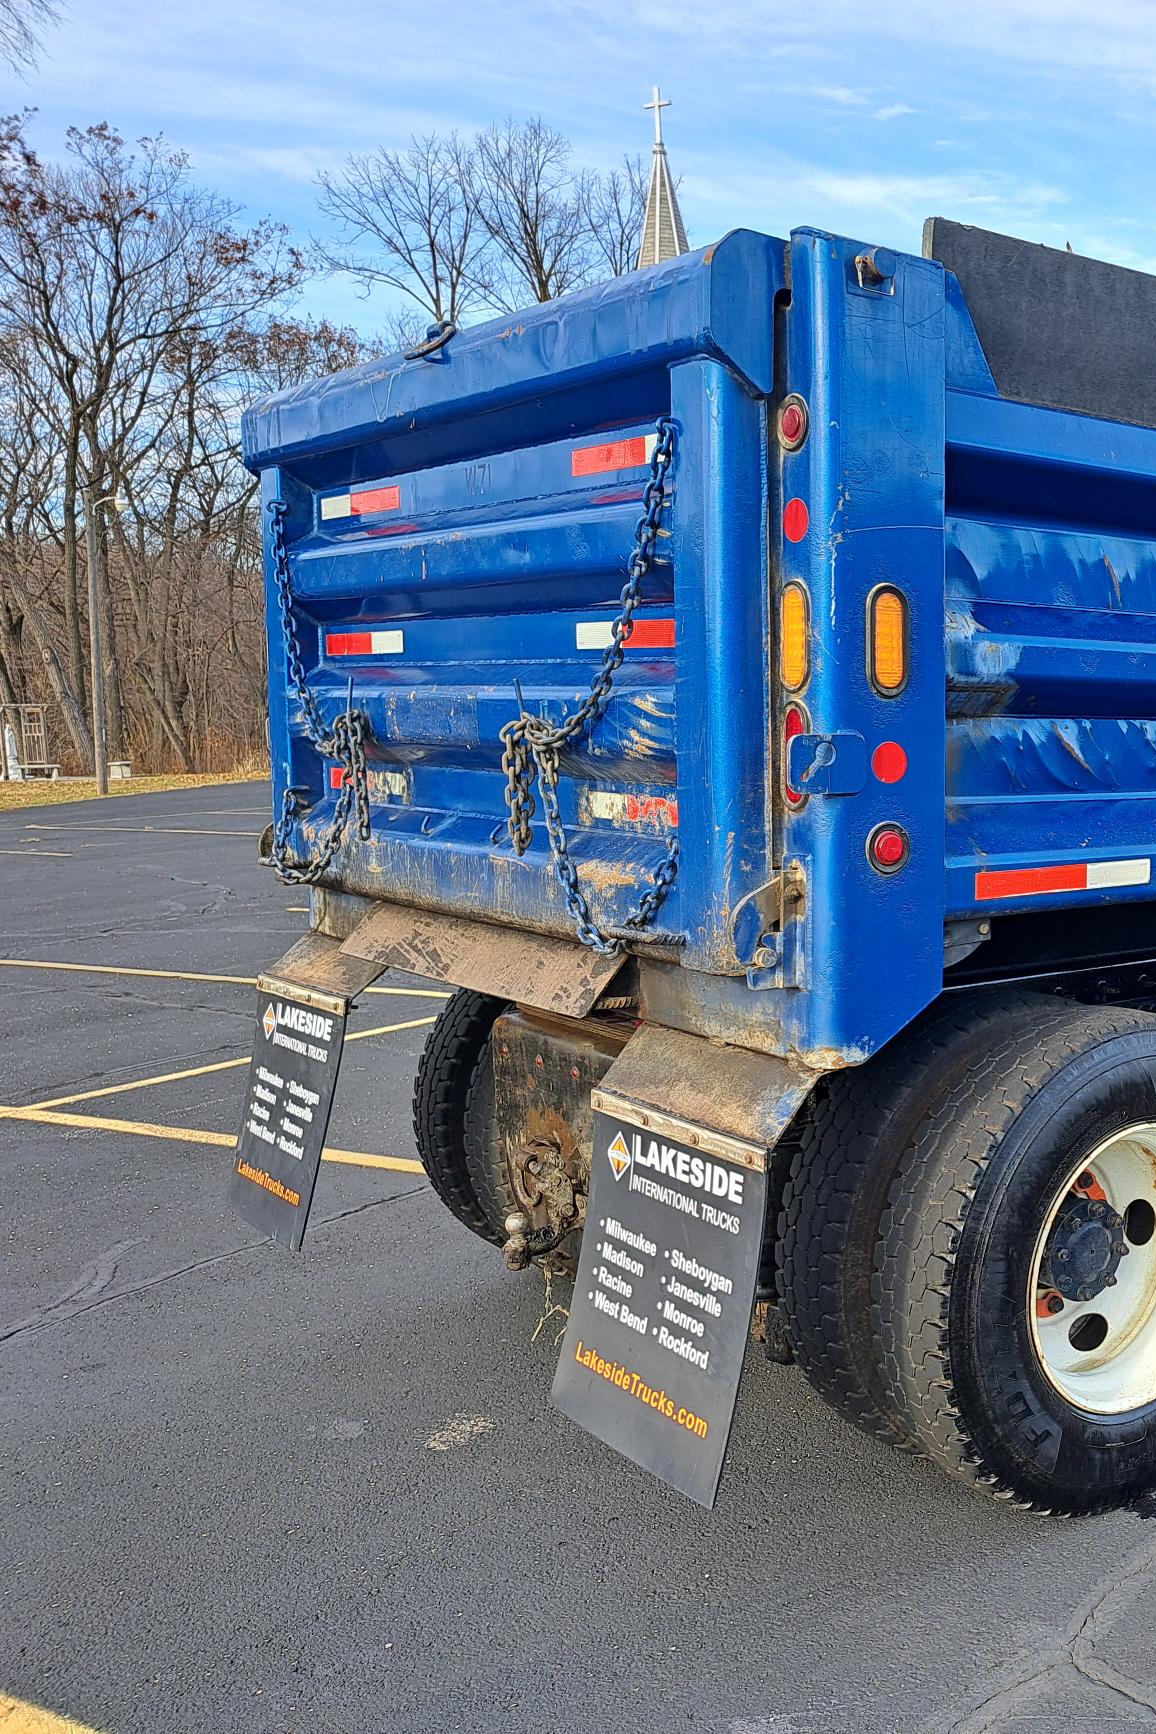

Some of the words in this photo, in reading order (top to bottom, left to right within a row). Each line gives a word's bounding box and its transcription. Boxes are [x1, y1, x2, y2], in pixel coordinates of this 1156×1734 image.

[277, 1002, 334, 1042] LAKESIDE
[275, 1033, 307, 1057] INTERNATIONAL
[307, 1043, 328, 1063] TRUCKS
[289, 1080, 320, 1107] Sheboygan
[279, 1135, 304, 1161] Rockford
[237, 1158, 301, 1207] LakesideTrucks.com
[634, 1133, 744, 1205] LAKESIDE
[632, 1174, 701, 1219] INTERNATIONAL
[701, 1203, 740, 1235] TRUCKS
[605, 1217, 657, 1258] Milwaukee
[602, 1243, 644, 1278] Madison
[671, 1249, 733, 1296] Sheboygan
[598, 1267, 633, 1299] Racine
[667, 1276, 722, 1318] Janesville
[594, 1292, 619, 1324] West
[619, 1303, 648, 1336] Bend
[663, 1301, 705, 1338] Monroe
[658, 1327, 709, 1371] Rockford
[575, 1342, 709, 1439] LakesideTrucks.com
